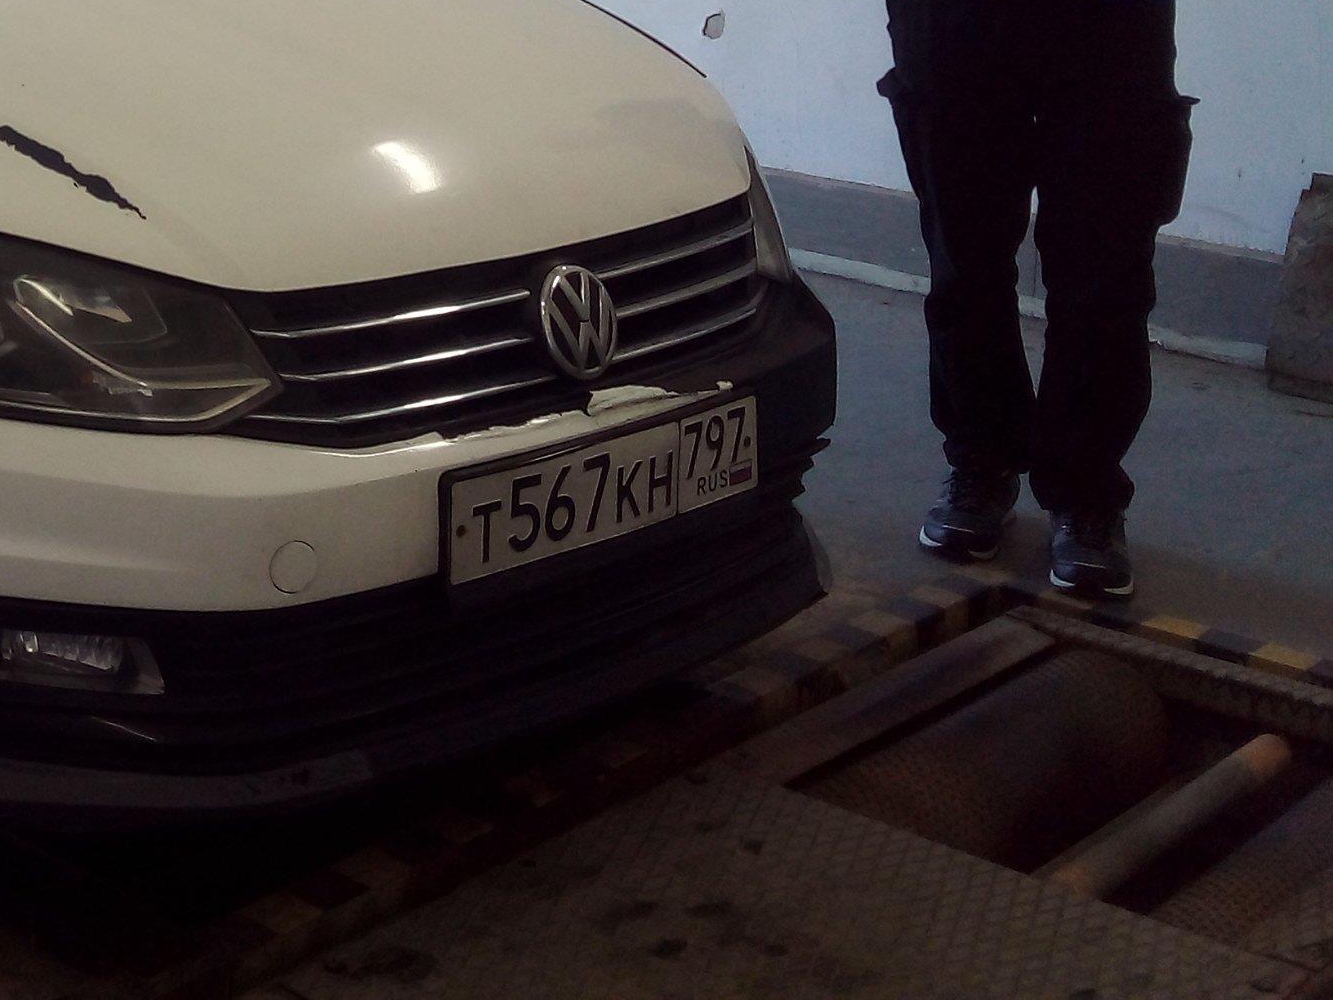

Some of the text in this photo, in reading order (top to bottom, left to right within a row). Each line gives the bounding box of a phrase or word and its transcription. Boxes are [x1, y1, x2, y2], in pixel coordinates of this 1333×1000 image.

[472, 407, 747, 563] Т567КН 797
[697, 470, 729, 496] RUS
